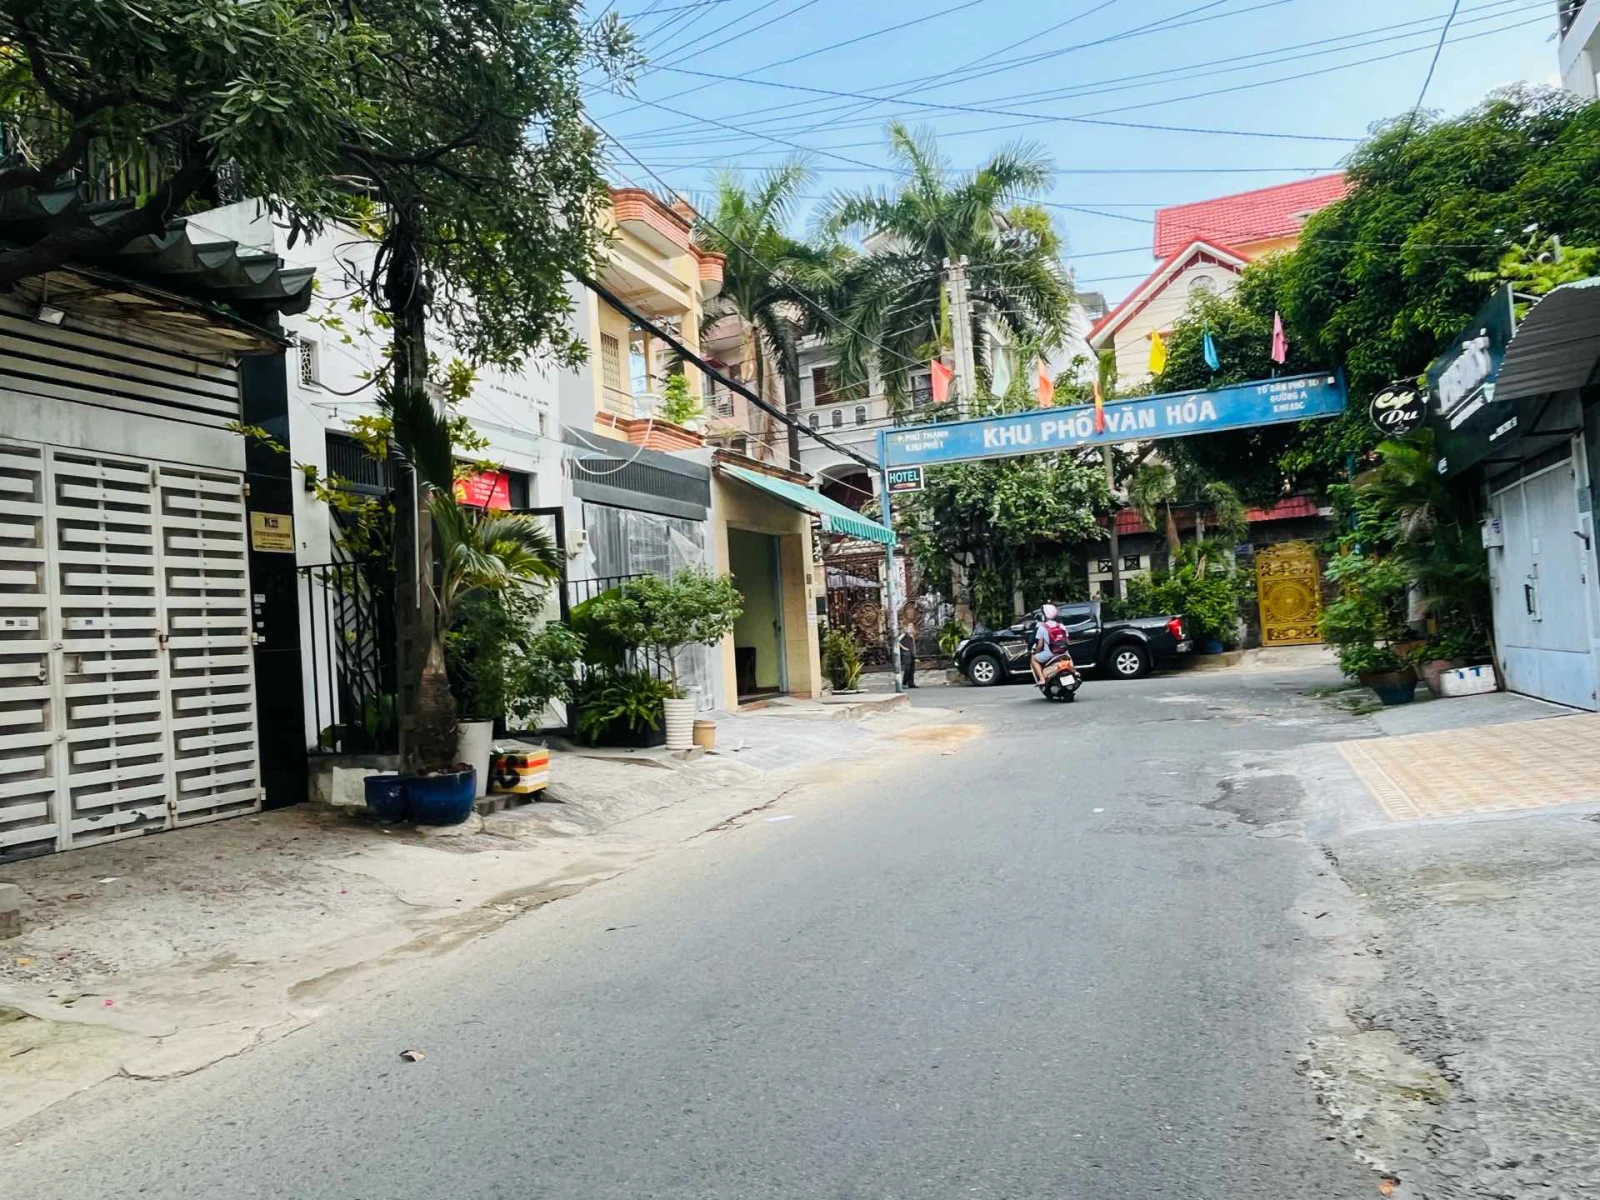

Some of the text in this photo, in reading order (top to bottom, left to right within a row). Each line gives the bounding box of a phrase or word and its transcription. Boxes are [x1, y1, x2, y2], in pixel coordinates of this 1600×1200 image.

[983, 396, 1217, 448] KHU PHỐ VĂN HÓA
[1380, 410, 1419, 424] Du
[889, 470, 920, 484] HOTEL
